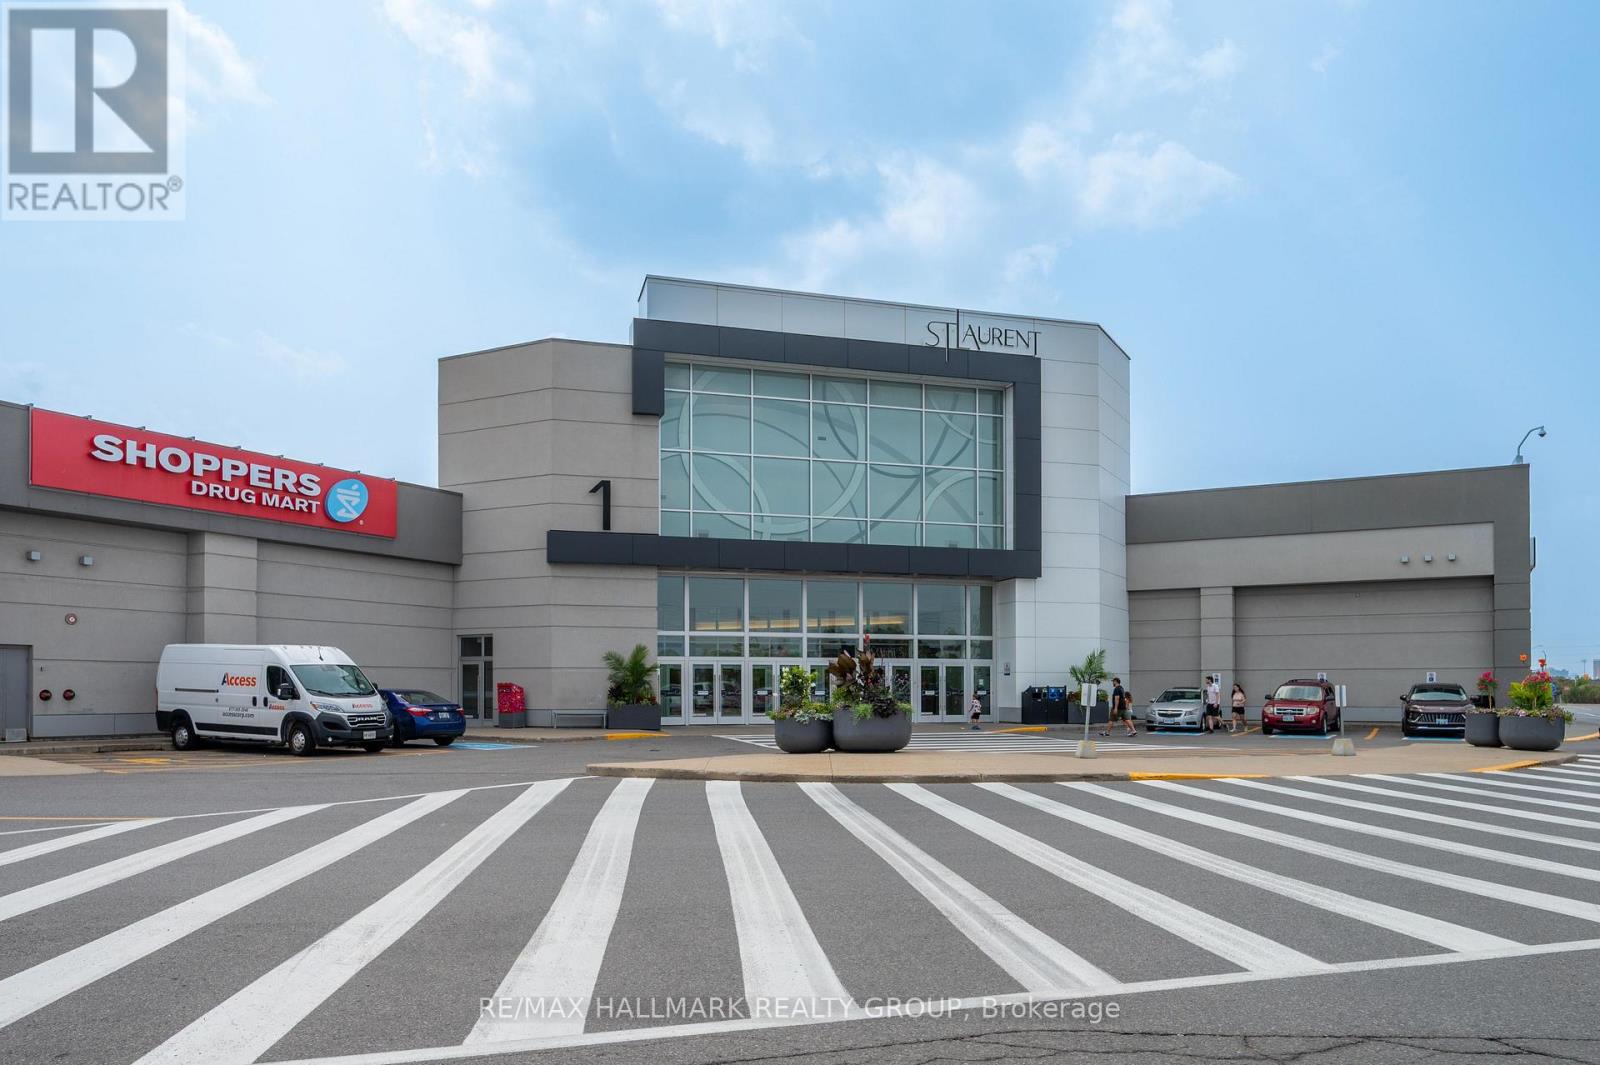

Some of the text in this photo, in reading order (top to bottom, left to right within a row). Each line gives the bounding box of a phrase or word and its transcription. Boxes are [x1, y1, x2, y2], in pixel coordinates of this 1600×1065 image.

[956, 309, 1042, 356] LAURENT
[90, 434, 321, 496] SHOPPERS
[191, 480, 321, 514] DRUG MART
[588, 479, 611, 531] 1
[221, 672, 257, 687] Access
